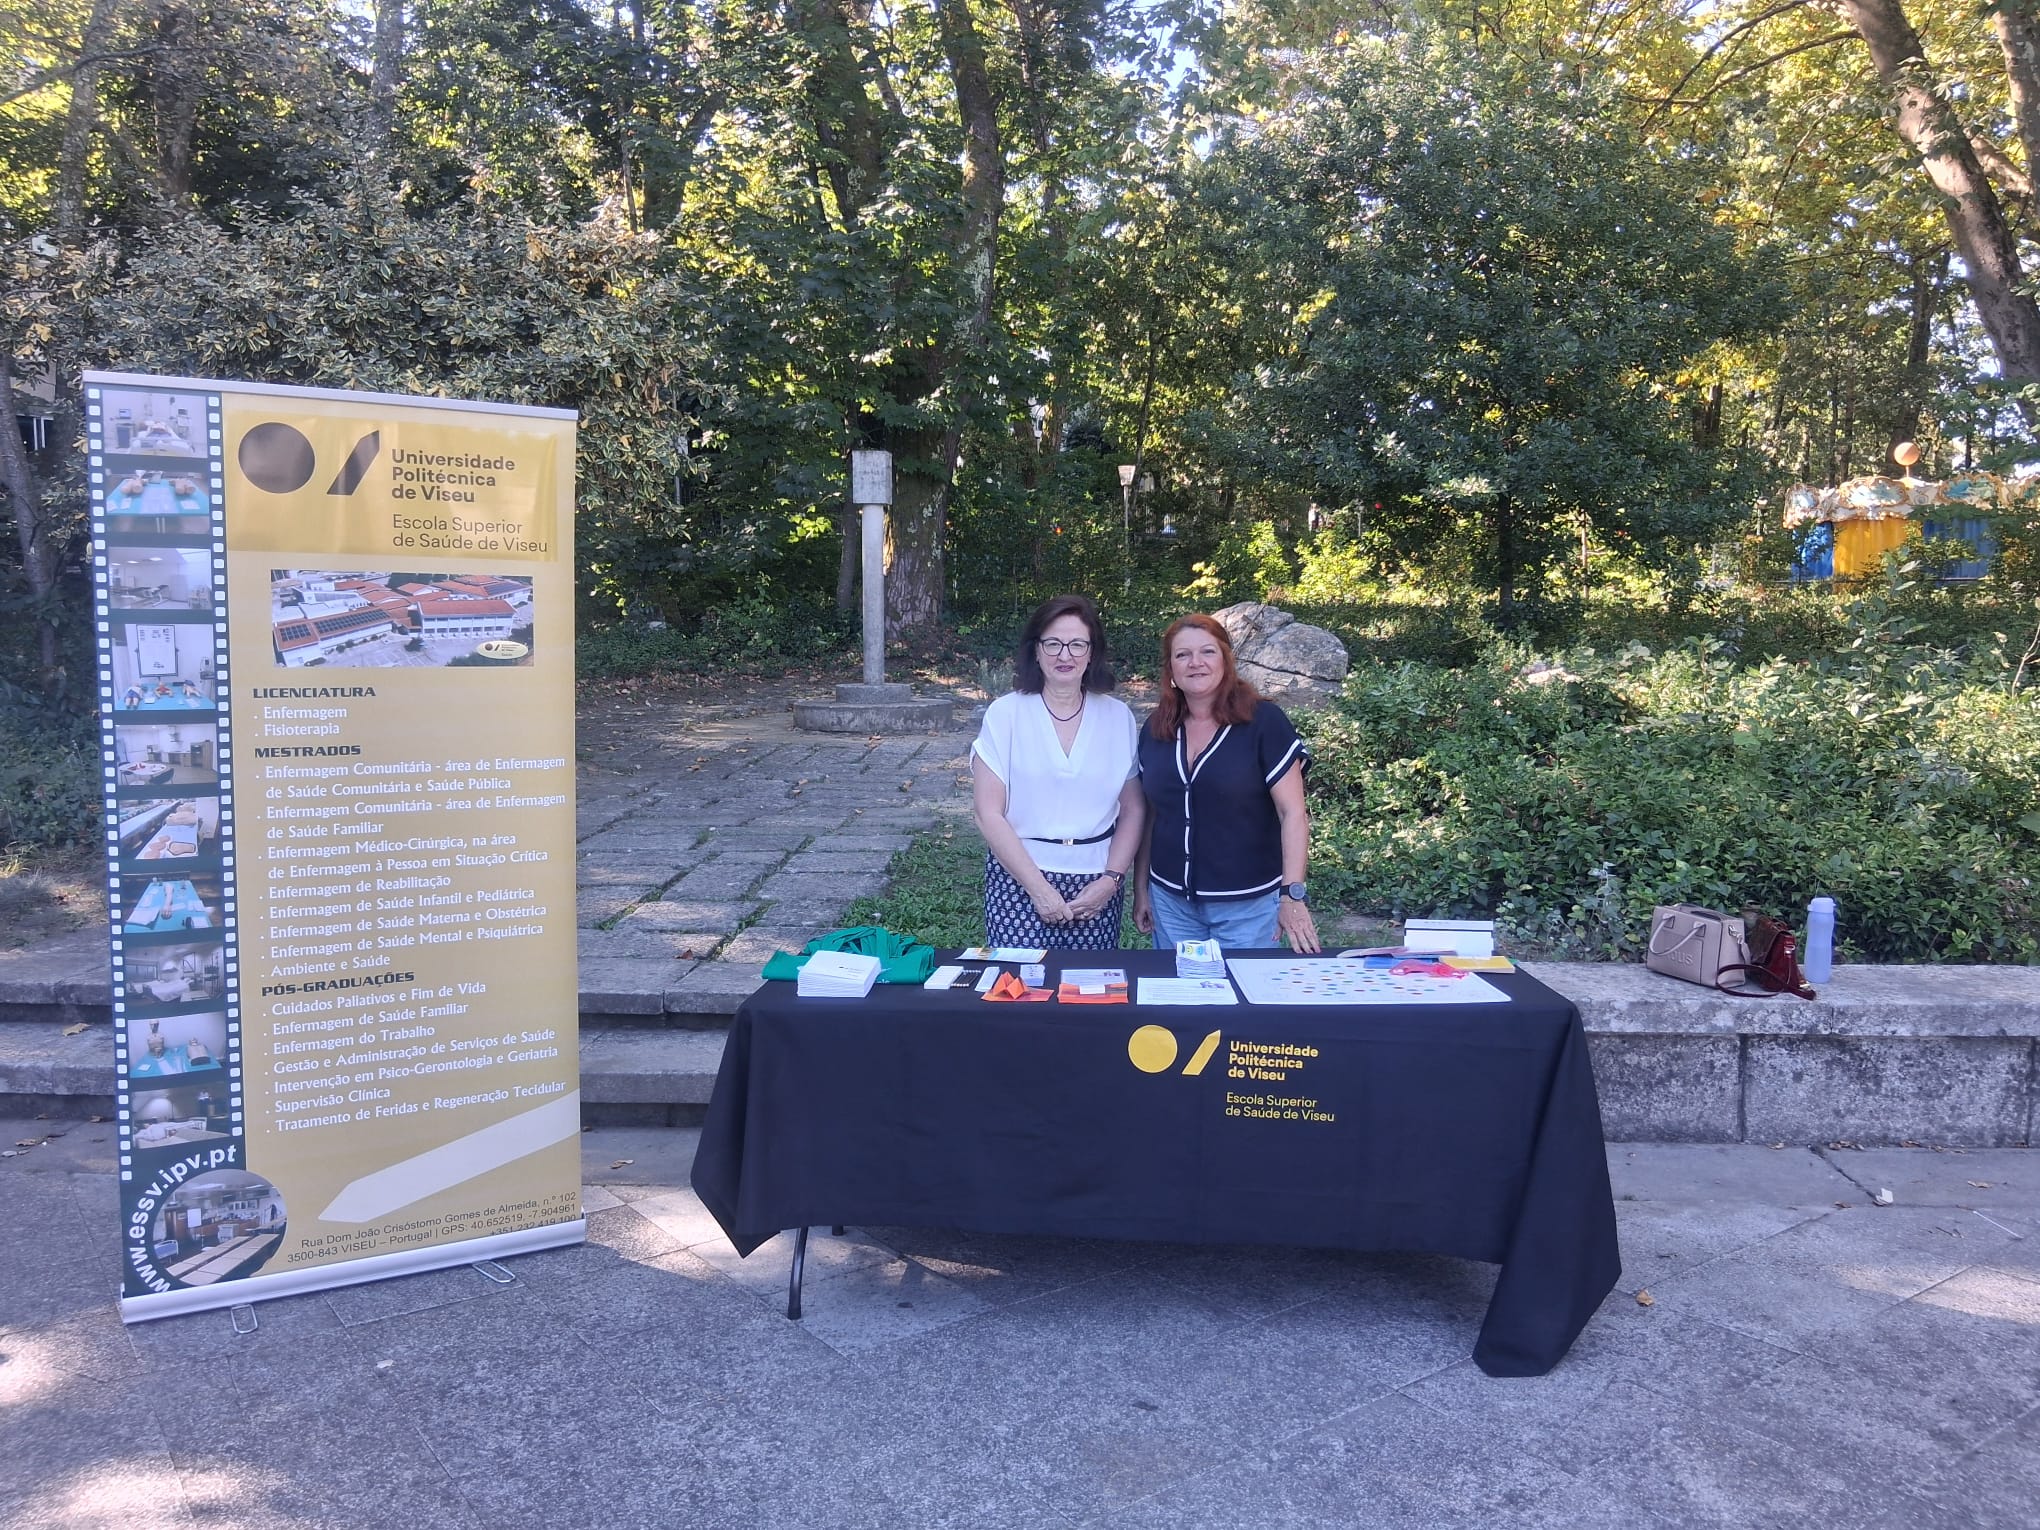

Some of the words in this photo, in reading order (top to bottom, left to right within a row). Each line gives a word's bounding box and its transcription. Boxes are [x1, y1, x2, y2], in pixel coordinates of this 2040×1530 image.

[392, 449, 515, 471] Universidade
[392, 466, 496, 487] Politécnica
[392, 485, 416, 500] de
[422, 486, 474, 502] Viseu
[393, 514, 447, 531] Escola
[452, 517, 522, 535] Superior
[393, 534, 414, 547] de
[420, 534, 472, 549] Saúde
[478, 536, 498, 550] de
[503, 537, 547, 552] Viseu
[253, 687, 376, 698] LICENCIATURA
[264, 707, 347, 721] Enfermagem
[264, 723, 339, 736] Fisioterapia
[255, 745, 360, 758] MESTRADOS
[265, 765, 348, 780] Enfermagem
[354, 761, 431, 776] Comunitária
[445, 760, 471, 772] área
[476, 759, 490, 771] de
[495, 757, 565, 771] Enfermagem
[266, 787, 282, 799] de
[288, 784, 327, 797] Saúde
[332, 781, 410, 796] Comunitária
[416, 783, 422, 792] e
[427, 779, 464, 791] Saúde
[468, 777, 511, 790] Pública
[267, 805, 349, 819] Enfermagem
[355, 800, 432, 815] Comunitária
[446, 799, 471, 809] área
[476, 797, 490, 809] de
[496, 794, 565, 808] Enfermagem
[267, 827, 283, 839] de
[288, 824, 328, 838] Saúde
[333, 822, 384, 835] Familiar
[268, 844, 350, 859] Enfermagem
[355, 837, 468, 854] Médico-Cirúrgica,
[472, 836, 486, 846] na
[491, 834, 516, 845] área
[268, 867, 284, 879] de
[290, 862, 370, 878] Enfermagem
[376, 860, 383, 871] à
[388, 858, 427, 871] Pessoa
[432, 858, 450, 867] em
[455, 853, 505, 867] Situação
[510, 850, 548, 863] Crítica
[269, 884, 350, 899] Enfermagem
[356, 881, 371, 892] de
[376, 875, 451, 891] Reabilitação
[270, 904, 351, 919] Enfermagem
[357, 900, 371, 911] de
[376, 897, 414, 910] Saúde
[419, 894, 461, 907] Infantil
[466, 894, 472, 902] e
[477, 888, 534, 902] Pediátrica
[270, 923, 352, 939] Enfermagem
[357, 919, 372, 931] de
[377, 916, 414, 929] Saúde
[419, 912, 470, 926] Materna
[475, 913, 481, 921] e
[486, 905, 546, 919] Obstétrica
[271, 942, 352, 959] Enfermagem
[358, 939, 372, 950] de
[377, 935, 414, 948] Saúde
[419, 930, 461, 945] Mental
[466, 931, 473, 940] e
[477, 924, 543, 939] Psiquiátrica
[271, 961, 335, 976] Ambiente
[341, 961, 347, 969] e
[353, 955, 390, 968] Saúde
[262, 972, 414, 996] PÓS-GRADUAÇÕES
[272, 999, 332, 1015] Cuidados
[337, 992, 396, 1010] Paliativos
[400, 993, 406, 1001] e
[411, 987, 432, 999] Fim
[438, 985, 452, 997] de
[457, 982, 486, 994] Vida
[273, 1017, 353, 1036] Enfermagem
[359, 1012, 373, 1024] de
[379, 1008, 416, 1021] Saúde
[420, 1003, 468, 1017] Familiar
[273, 1037, 353, 1055] Enfermagem
[359, 1032, 375, 1044] do
[380, 1024, 435, 1040] Trabalho
[1231, 1041, 1318, 1057] Universidade
[274, 1059, 319, 1074] Gestão
[323, 1060, 330, 1069] e
[336, 1046, 426, 1066] Administração
[431, 1041, 446, 1053] de
[450, 1035, 498, 1052] Serviços
[503, 1032, 517, 1044] de
[522, 1029, 555, 1041] Saúde
[1229, 1053, 1303, 1068] Politécnica
[275, 1076, 349, 1095] Intervenção
[355, 1072, 373, 1082] em
[379, 1055, 492, 1080] Psico-Gerontologia
[497, 1054, 504, 1062] e
[509, 1047, 557, 1061] Geriatria
[1228, 1066, 1245, 1078] de
[1248, 1068, 1285, 1081] Viseu
[275, 1097, 343, 1115] Supervisão
[348, 1087, 390, 1102] Clínica
[276, 1112, 350, 1132] Tratamento
[355, 1107, 370, 1120] de
[375, 1101, 418, 1117] Feridas
[423, 1102, 429, 1111] e
[434, 1089, 509, 1109] Regeneração
[514, 1081, 565, 1096] Tecidular
[1227, 1092, 1263, 1105] Escola
[1267, 1095, 1317, 1108] Superior
[1226, 1105, 1240, 1116] de
[1244, 1106, 1280, 1118] Saúde
[1283, 1109, 1298, 1119] de
[1302, 1110, 1335, 1121] Viseu
[129, 1144, 237, 1292] www.essv.ipv.pt
[302, 1237, 323, 1248] Rua
[327, 1232, 352, 1244] Dom
[355, 1227, 380, 1239] João
[384, 1218, 441, 1234] Crisóstomo
[444, 1211, 480, 1223] Gomes
[483, 1208, 496, 1216] de
[560, 1192, 576, 1202] 102
[288, 1246, 338, 1263] 3500-843
[342, 1240, 377, 1253] VISEU
[390, 1230, 433, 1244] Portugal
[442, 1224, 468, 1235] GPS:
